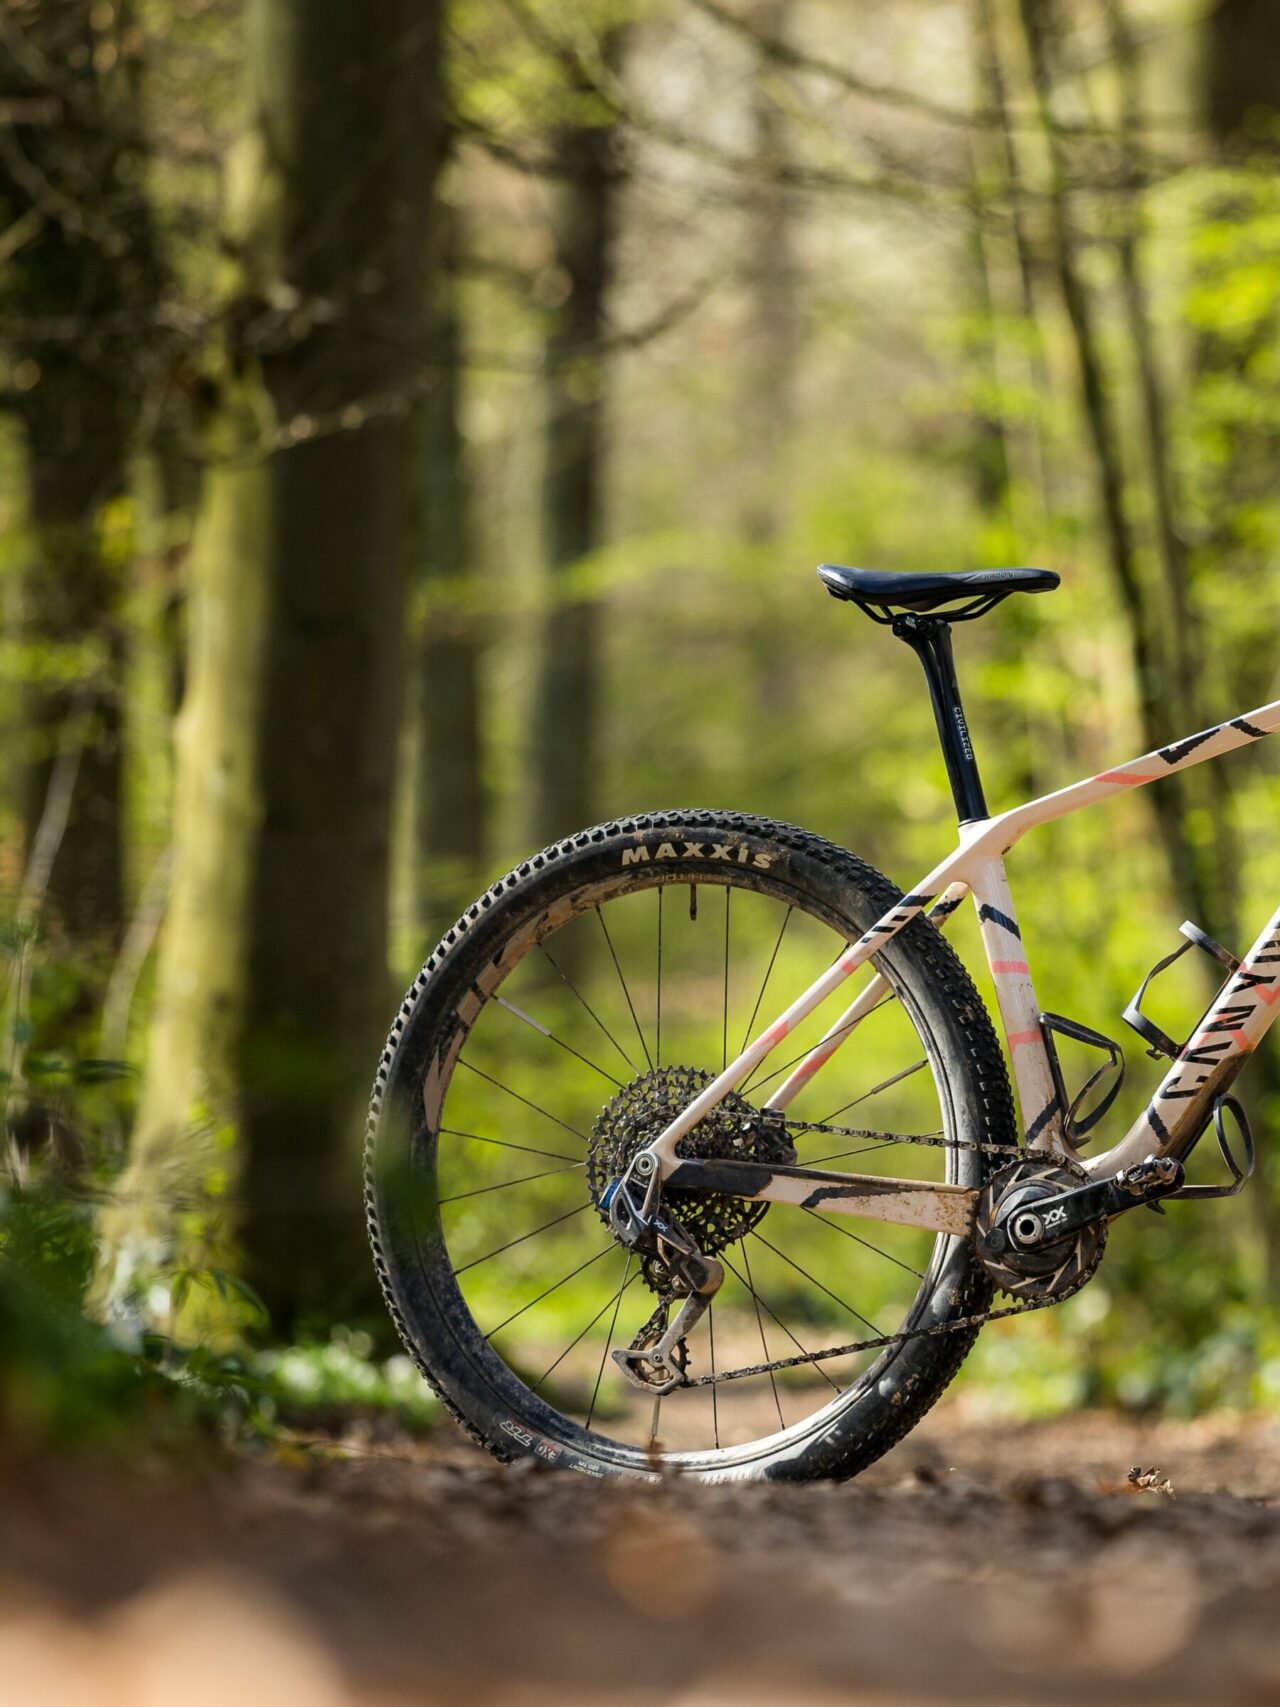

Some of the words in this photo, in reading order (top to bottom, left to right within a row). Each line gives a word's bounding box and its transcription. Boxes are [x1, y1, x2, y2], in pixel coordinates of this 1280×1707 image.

[621, 841, 771, 869] MAXXIS
[1042, 1205, 1067, 1225] XX
[653, 1219, 668, 1233] XX
